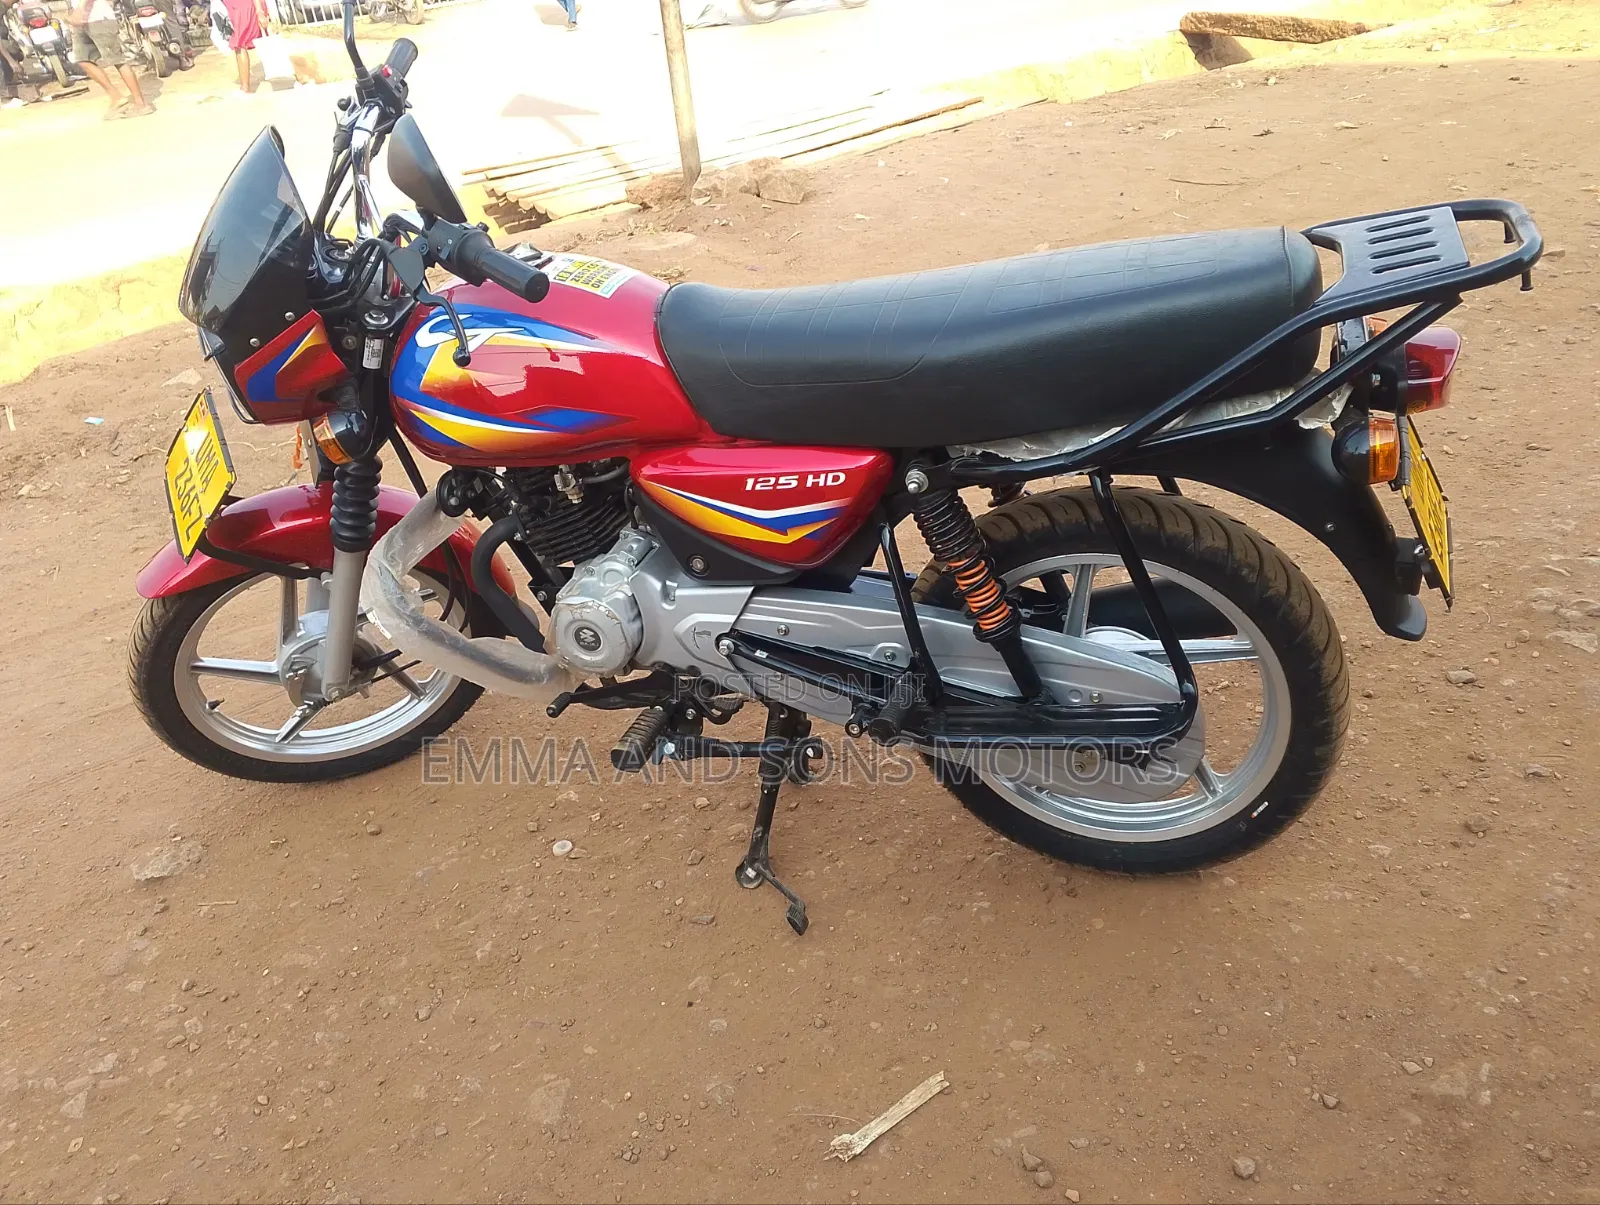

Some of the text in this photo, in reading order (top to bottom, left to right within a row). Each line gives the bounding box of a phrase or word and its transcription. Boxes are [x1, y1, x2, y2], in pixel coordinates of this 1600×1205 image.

[195, 431, 219, 493] UMA
[745, 472, 846, 491] 125 HD
[174, 457, 203, 542] 236FZ
